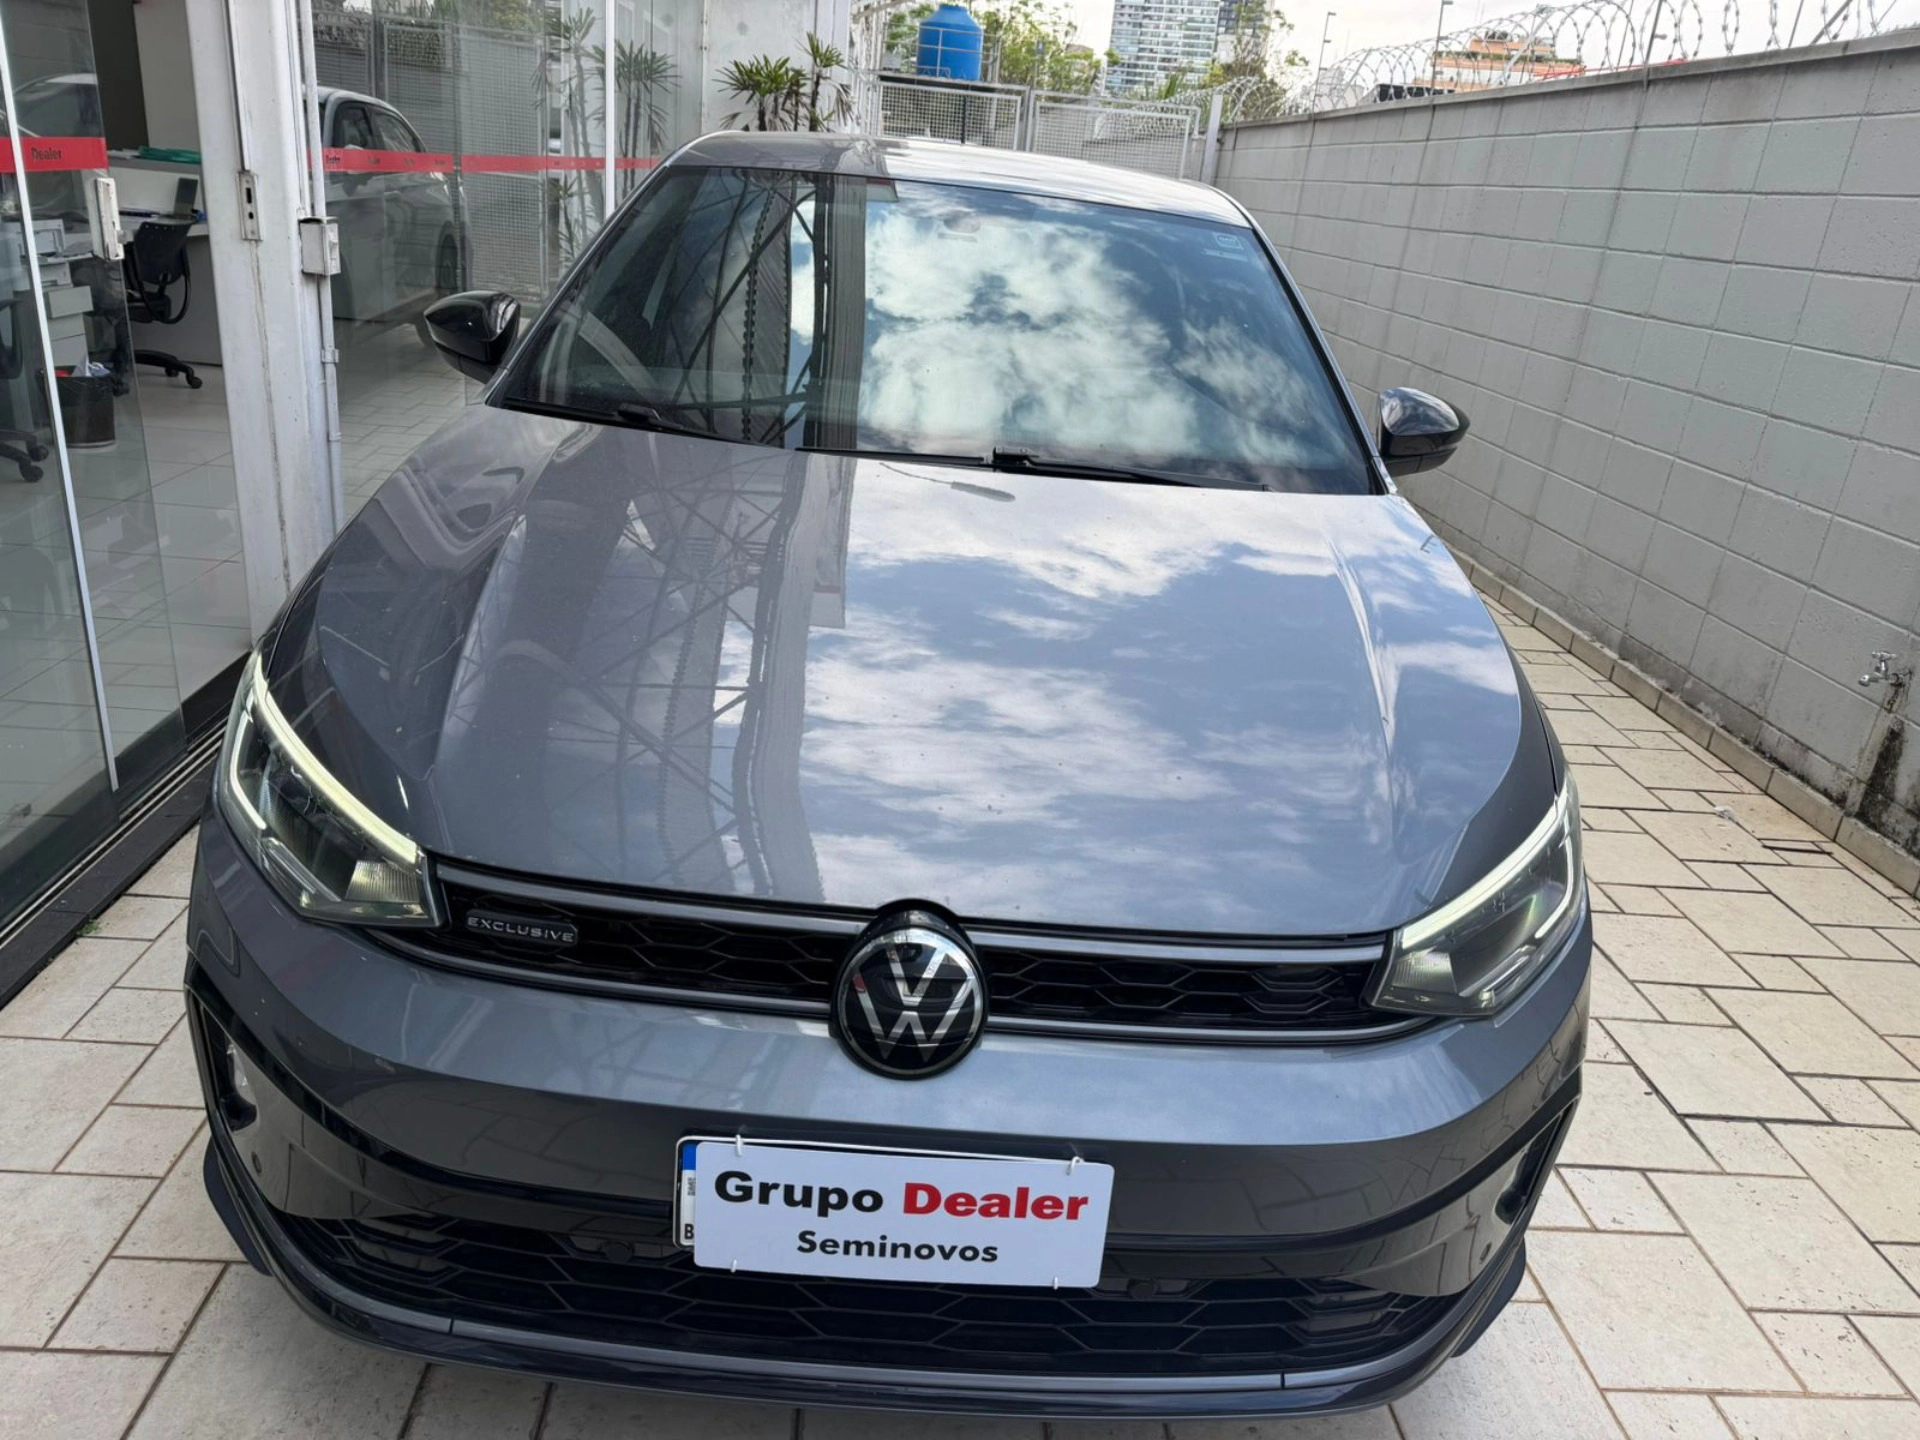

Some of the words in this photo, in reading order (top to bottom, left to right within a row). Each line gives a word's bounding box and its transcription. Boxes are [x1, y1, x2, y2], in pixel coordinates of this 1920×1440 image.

[467, 917, 574, 942] EXCLUSIVE
[714, 1170, 884, 1218] Grupo
[903, 1182, 1089, 1221] Dealer
[796, 1229, 998, 1263] Seminovos
